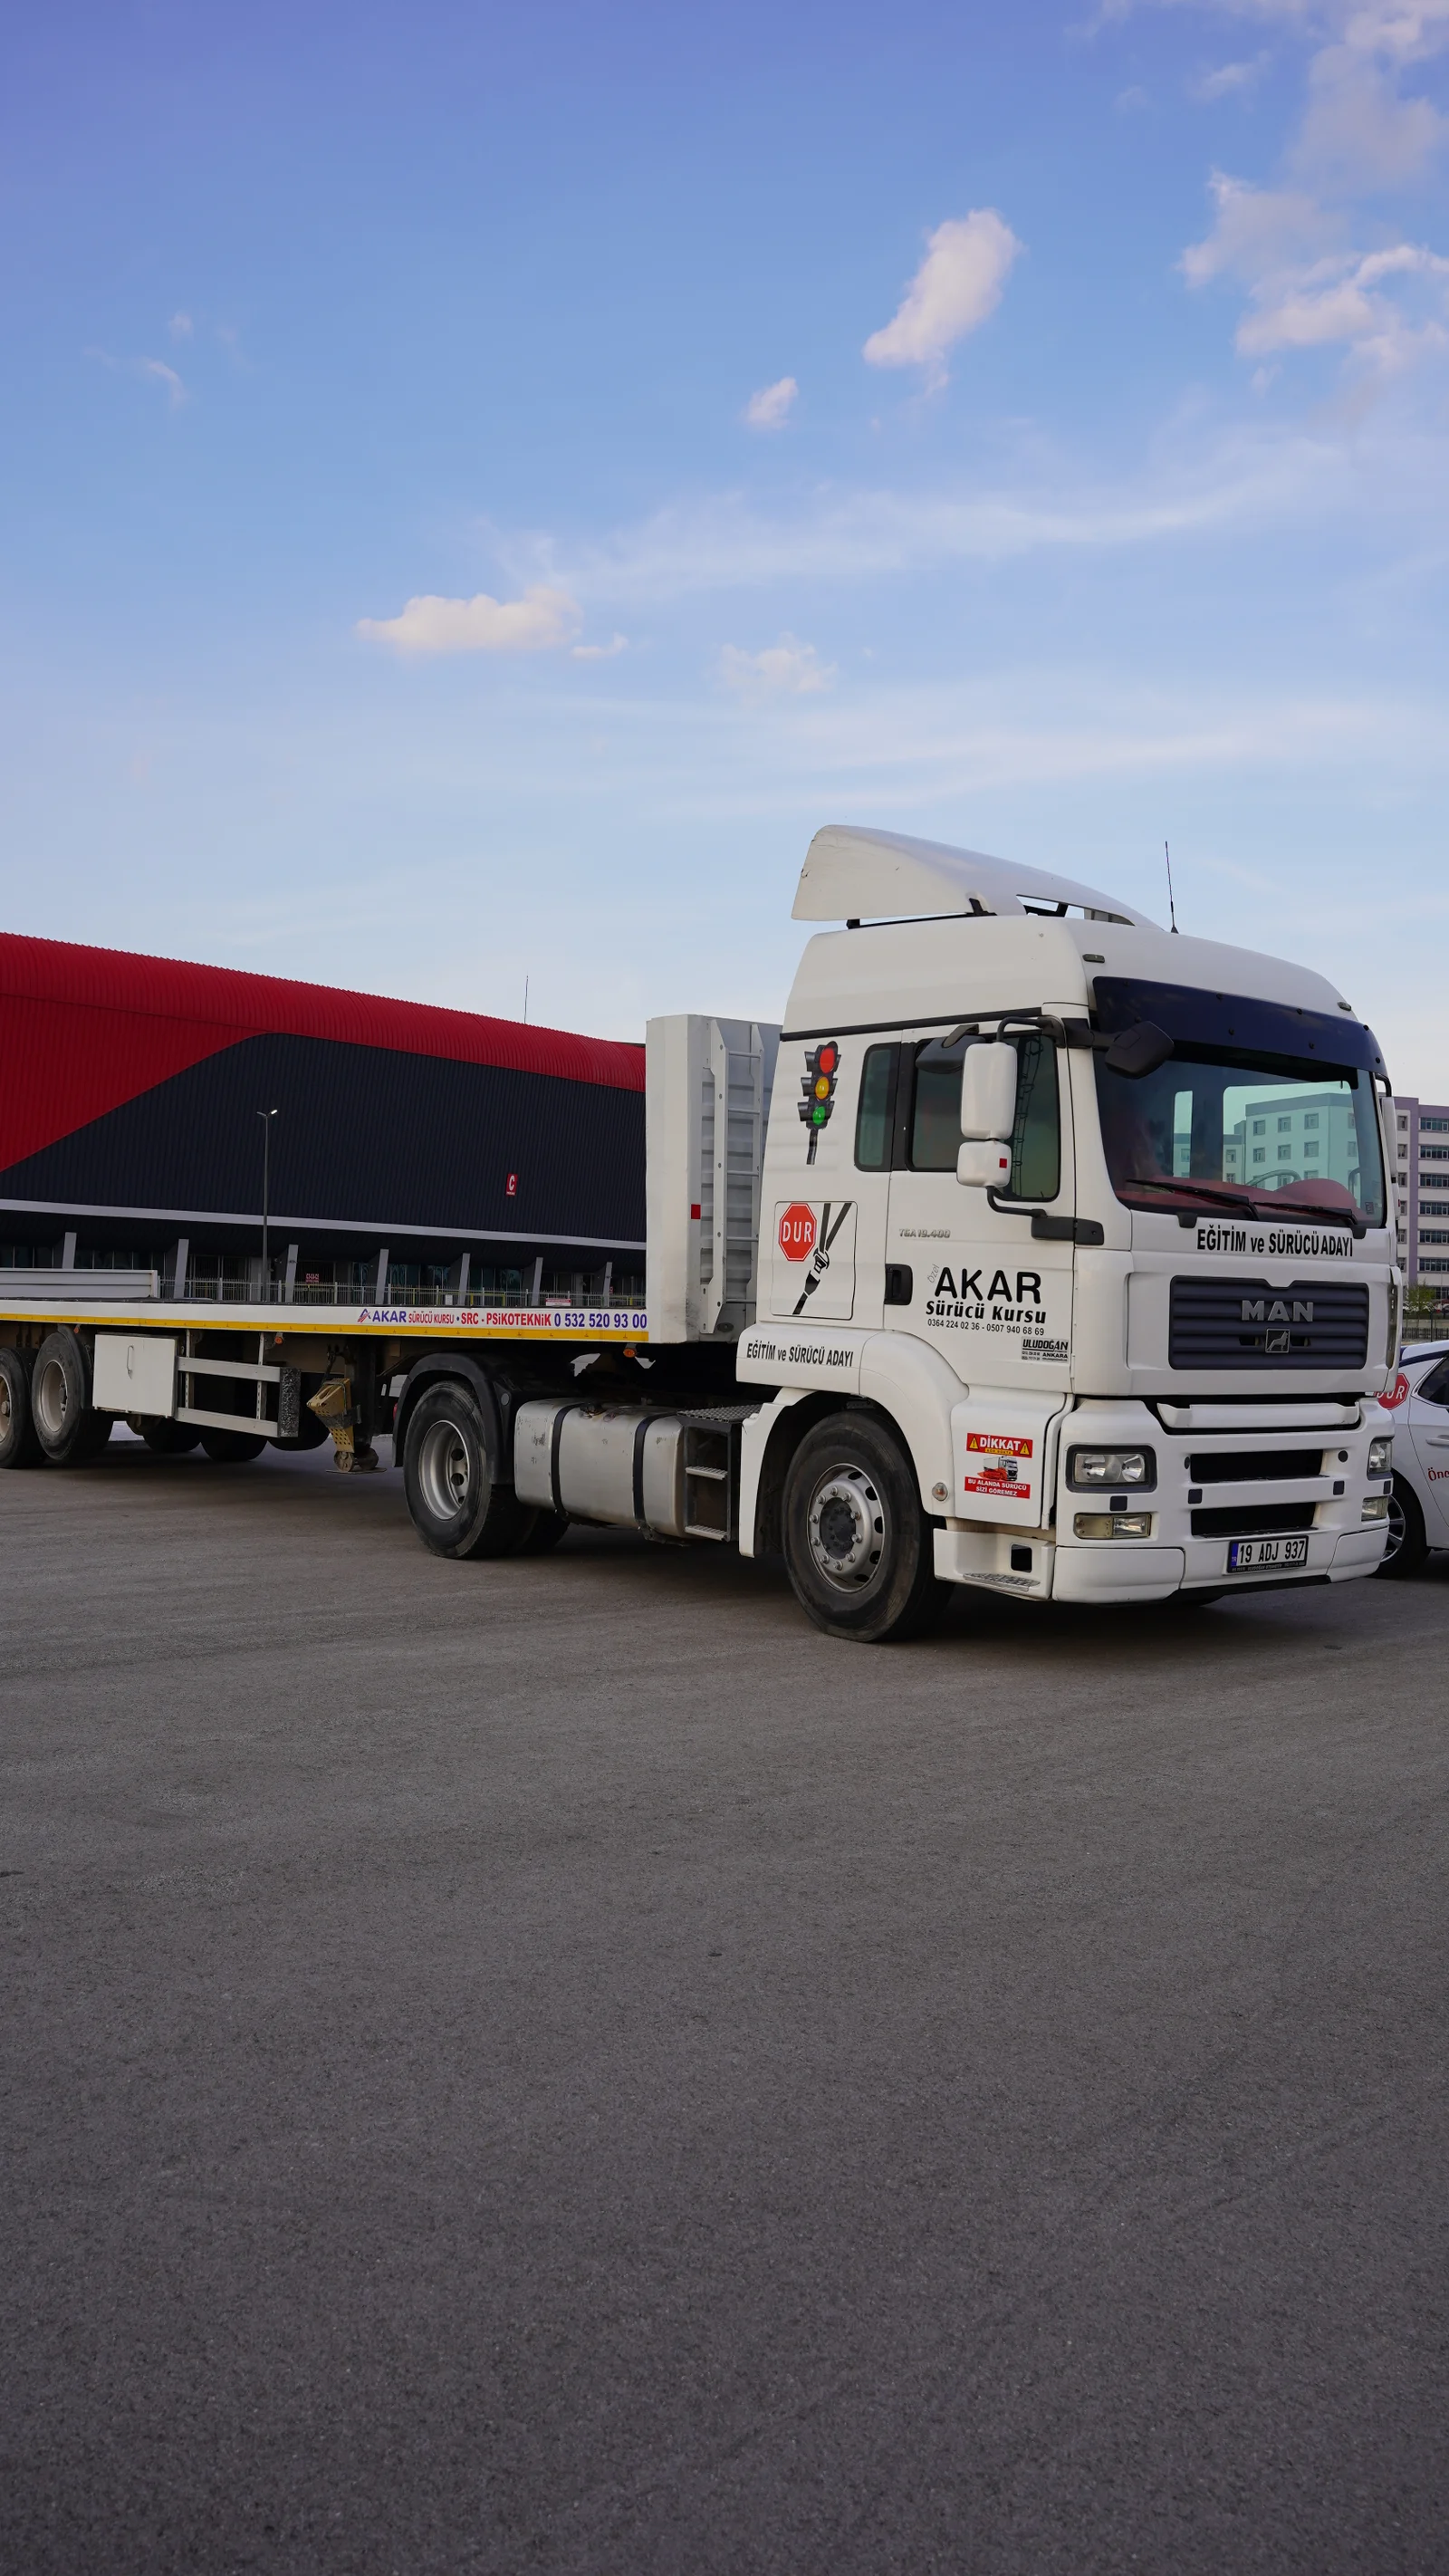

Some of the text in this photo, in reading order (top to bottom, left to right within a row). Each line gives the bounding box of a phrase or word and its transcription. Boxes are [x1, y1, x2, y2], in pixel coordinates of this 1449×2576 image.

[509, 1175, 515, 1191] C
[782, 1221, 812, 1243] DUR
[1197, 1224, 1353, 1257] EĞİTİM ve SÜRÜCÜ ADAYI
[926, 1264, 940, 1283] Özel
[935, 1267, 1041, 1304] AKAR
[372, 1310, 407, 1323] AKAR
[408, 1311, 433, 1324] SÜRÜCÜ
[434, 1312, 455, 1324] KURSU
[461, 1312, 479, 1325] SRC
[554, 1312, 561, 1327] 0
[564, 1312, 585, 1328] 532
[589, 1313, 610, 1328] 520
[614, 1313, 629, 1328] 93
[632, 1313, 648, 1329] 00
[926, 1300, 1046, 1324] Sürücü Kursu
[1242, 1300, 1314, 1322] MAN
[927, 1318, 945, 1327] 0364
[945, 1320, 958, 1329] 224
[960, 1322, 969, 1330] 02
[971, 1322, 980, 1331] 36
[986, 1323, 1004, 1332] 0507
[1006, 1325, 1021, 1334] 940
[1022, 1326, 1032, 1335] 68
[1034, 1327, 1044, 1336] 69
[746, 1340, 854, 1367] EĞİTİM ve SÜRÜCÜ ADAYI
[1022, 1339, 1069, 1350] ULUDOĞAN
[980, 1435, 1021, 1451] DİKKAT
[988, 1487, 1018, 1496] GÖREMEZ
[1002, 1482, 1027, 1491] SÜRÜCÜ
[1240, 1544, 1252, 1563] 19
[1258, 1542, 1279, 1562] ADJ
[1284, 1540, 1305, 1560] 937
